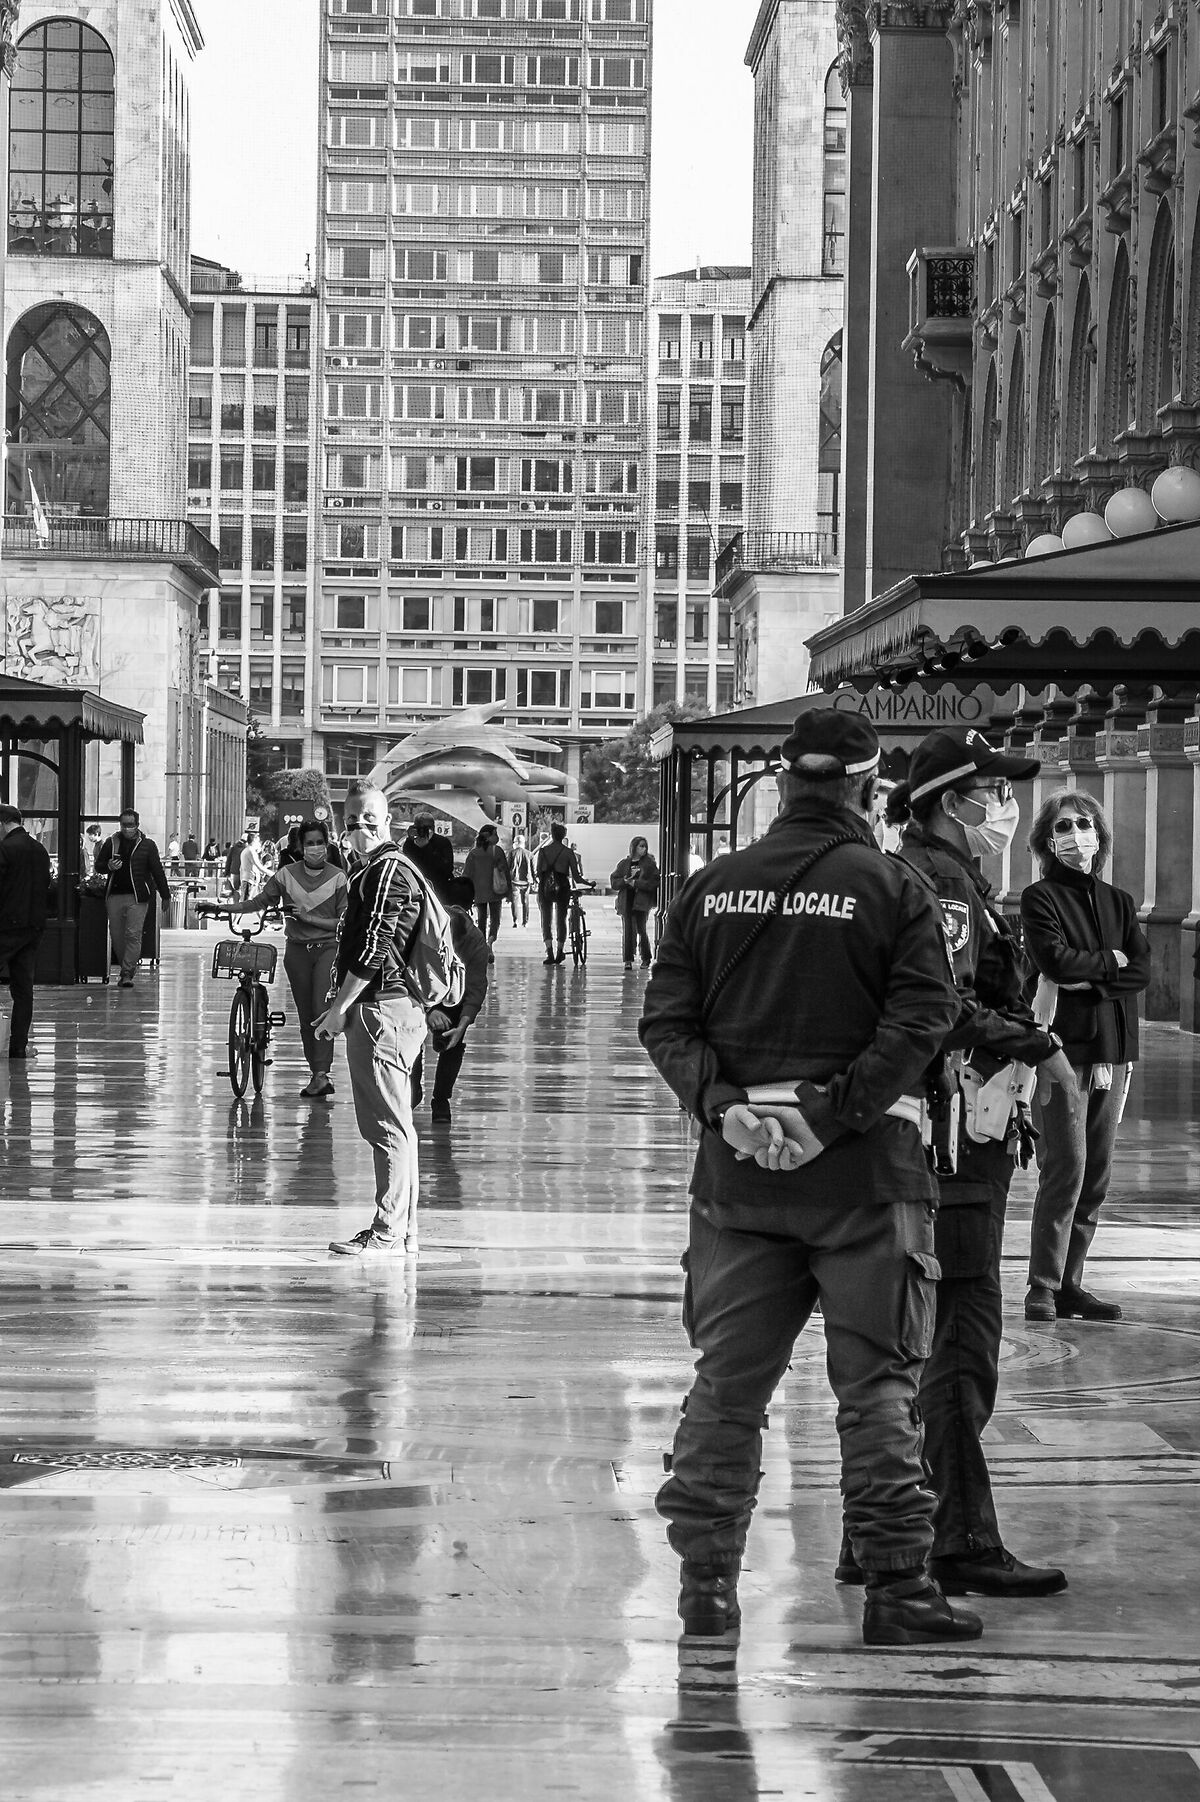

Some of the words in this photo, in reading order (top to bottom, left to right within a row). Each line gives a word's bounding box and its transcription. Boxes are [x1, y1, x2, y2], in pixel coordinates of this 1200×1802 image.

[833, 694, 982, 720] CAMPARINO
[703, 890, 777, 917] POLIZIA
[782, 891, 857, 920] LOCALE
